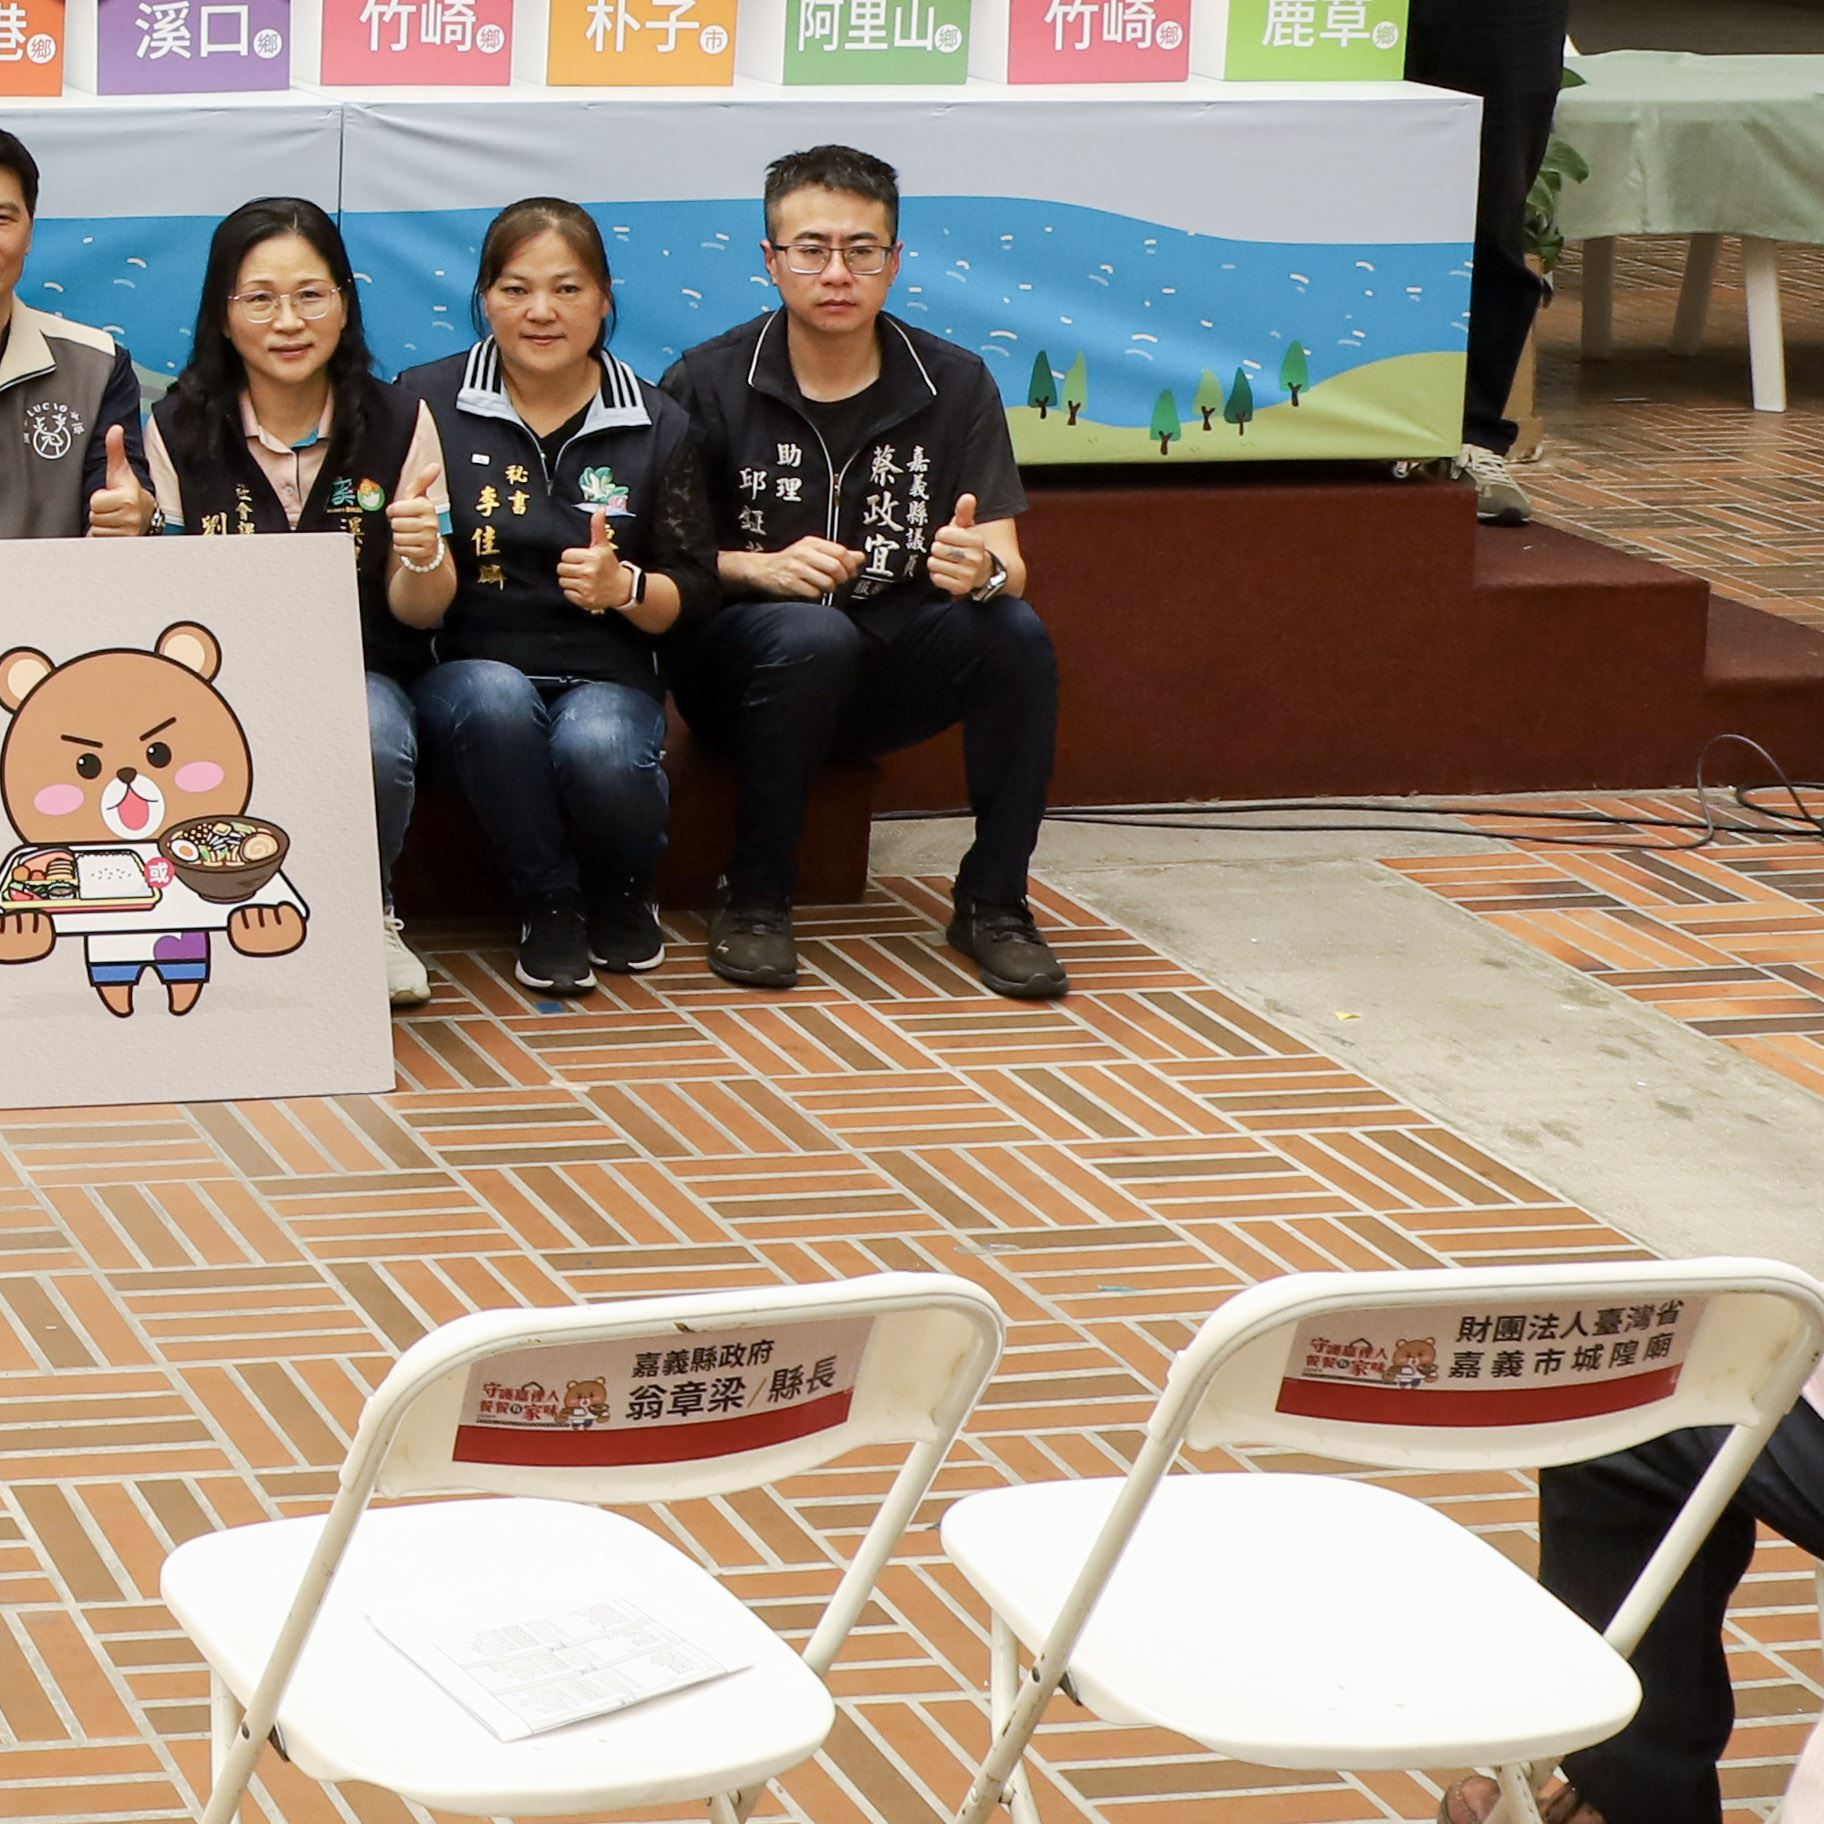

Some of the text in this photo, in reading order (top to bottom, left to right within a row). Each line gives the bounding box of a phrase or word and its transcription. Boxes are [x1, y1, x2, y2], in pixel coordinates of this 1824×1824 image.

[505, 464, 531, 515] 秘書
[775, 443, 802, 502] 助理
[863, 444, 905, 576] 蔡政宜
[147, 860, 171, 884] 或
[1456, 1298, 1684, 1343] 財團法人臺灣省
[631, 1339, 775, 1379] 嘉義縣政府
[1448, 1332, 1675, 1379] 嘉義市城隍廟
